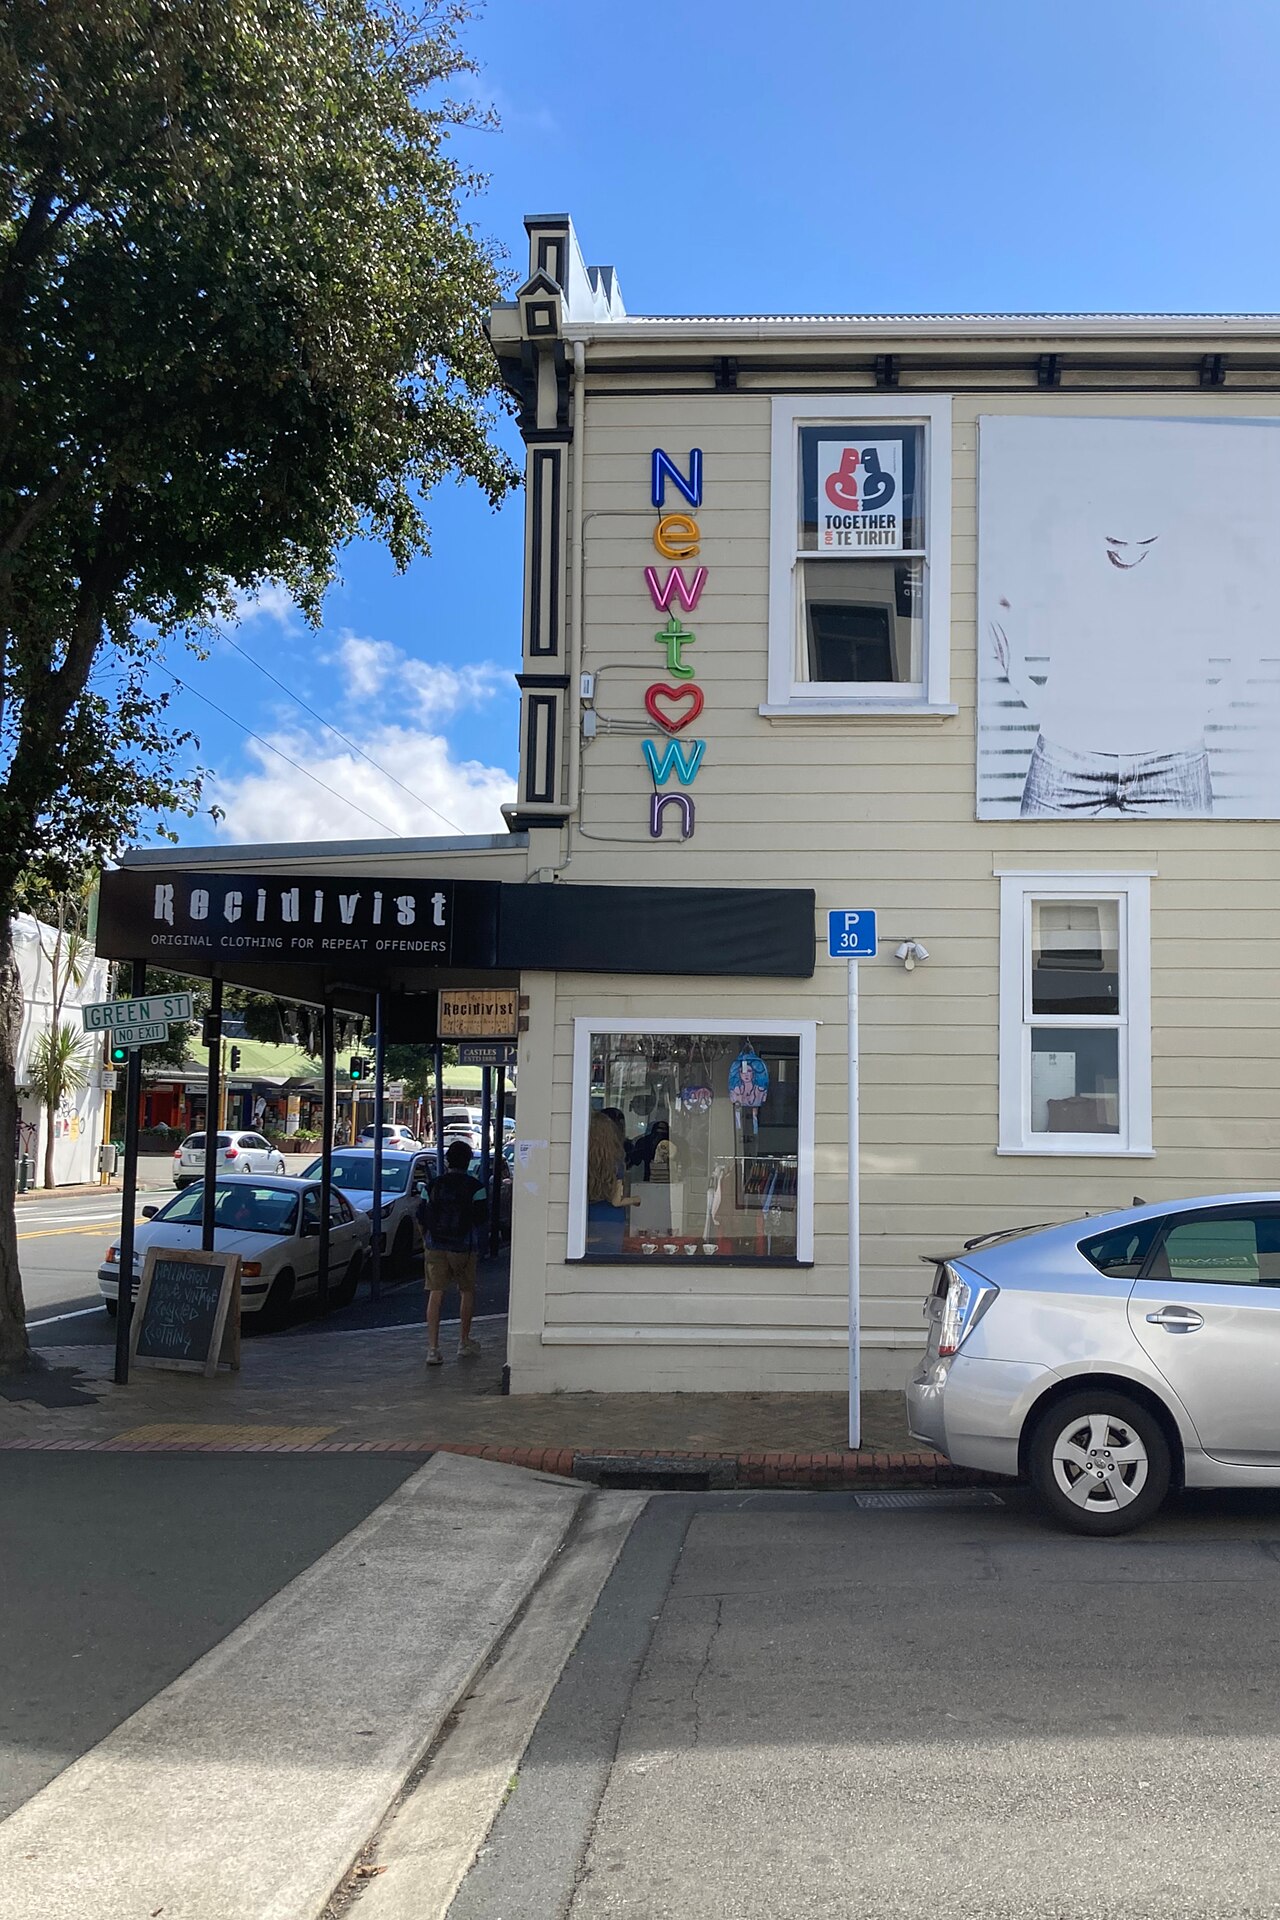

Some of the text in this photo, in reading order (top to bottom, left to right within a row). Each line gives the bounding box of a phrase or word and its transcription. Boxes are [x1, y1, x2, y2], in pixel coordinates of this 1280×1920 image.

[825, 515, 896, 529] TOGETHER
[825, 531, 833, 545] FOR
[836, 530, 896, 545] TE TIRITI
[153, 883, 447, 926] Recidivist
[844, 913, 860, 931] P
[151, 934, 447, 952] ORIGINAL CLOTHING FOR REPEAT OFFENDERS
[840, 933, 858, 948] 30
[90, 998, 184, 1026] GREEN ST
[444, 1002, 513, 1017] Recidivist
[119, 1025, 160, 1042] NO EXIT
[463, 1048, 497, 1056] CASTLES
